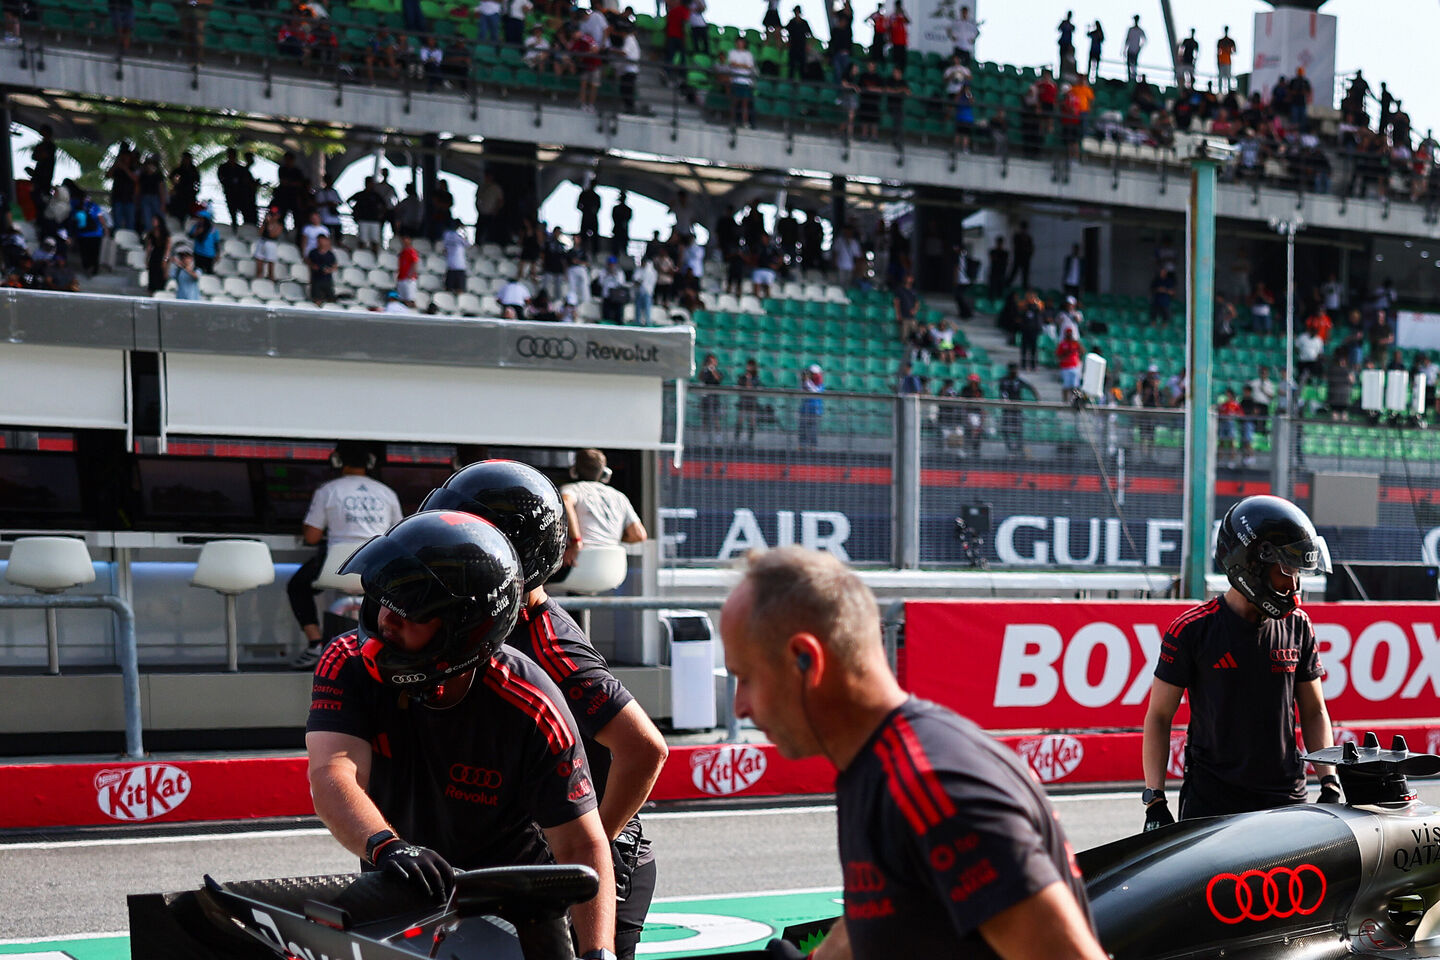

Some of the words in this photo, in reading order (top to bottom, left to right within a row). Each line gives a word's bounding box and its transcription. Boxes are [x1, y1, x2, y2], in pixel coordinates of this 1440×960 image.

[586, 341, 660, 362] Revolut
[717, 508, 852, 562] AIR
[994, 514, 1184, 567] GULF
[388, 602, 407, 618] berlin
[452, 655, 480, 671] Castrol
[702, 748, 762, 793] KitKat
[109, 766, 187, 818] KitKat
[445, 784, 499, 806] Revolut
